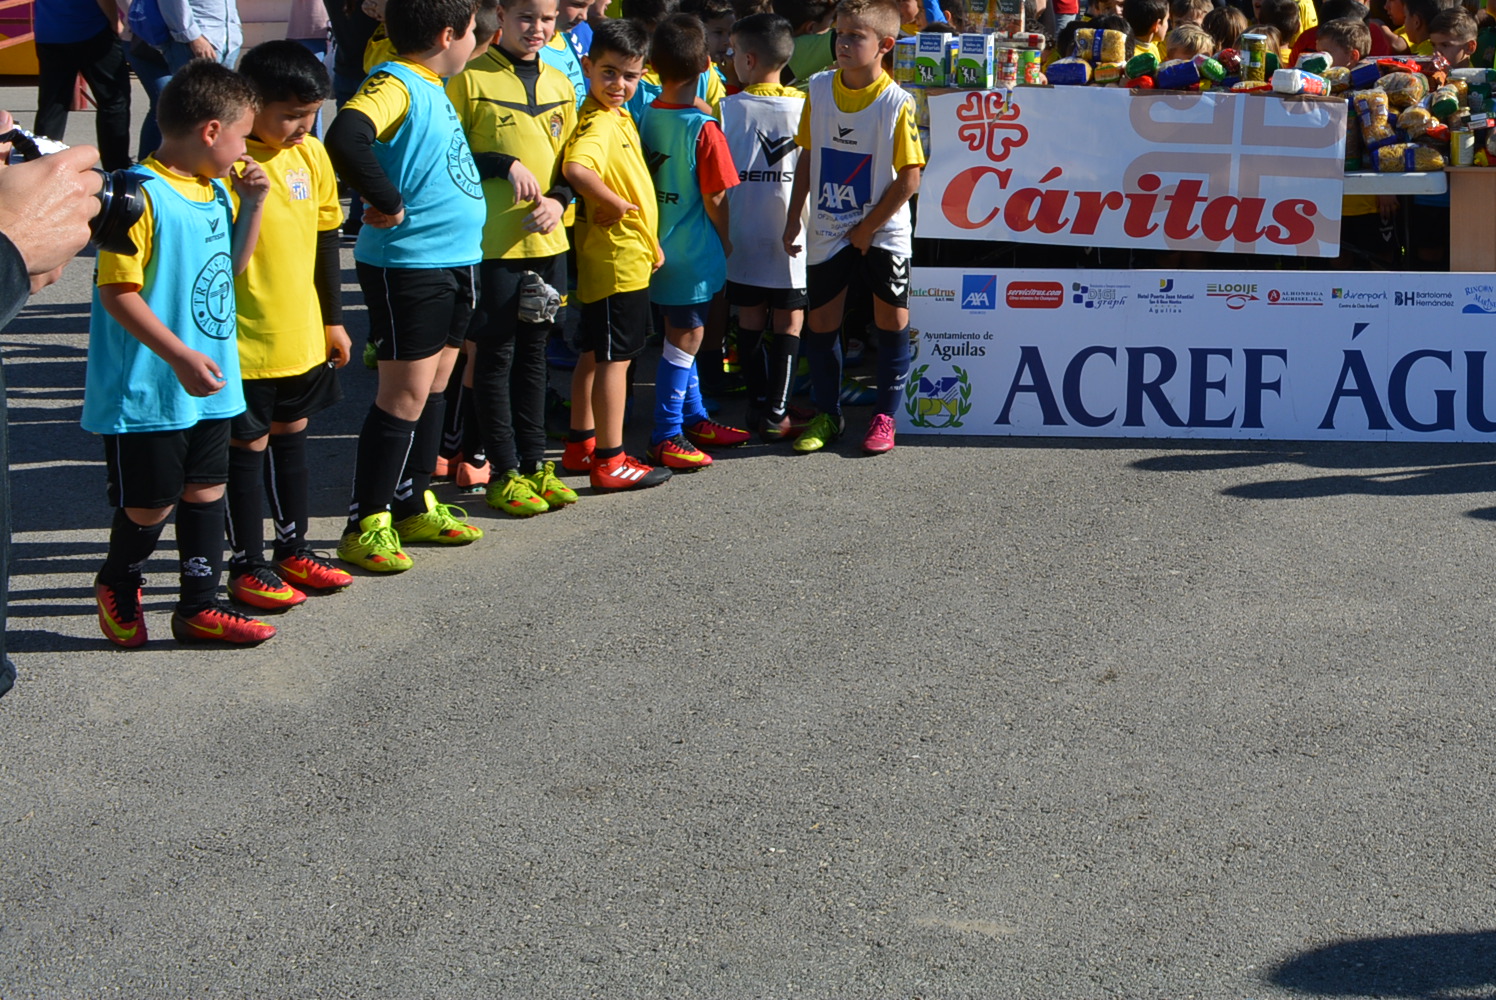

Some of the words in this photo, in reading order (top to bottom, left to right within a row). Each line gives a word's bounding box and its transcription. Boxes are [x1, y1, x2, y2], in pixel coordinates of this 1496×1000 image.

[738, 170, 794, 183] BEMIS
[818, 182, 859, 209] AXA
[941, 166, 1317, 245] Cáritas
[1007, 289, 1062, 297] servicitrus.com
[1218, 284, 1258, 294] LOOIJE
[1416, 291, 1453, 299] Bartolomé
[962, 292, 990, 306] AXA
[1416, 299, 1454, 307] Hernández
[924, 331, 981, 342] Ayuntamiento
[983, 331, 994, 340] de
[931, 339, 986, 361] Águilas
[994, 346, 1288, 428] ACREF
